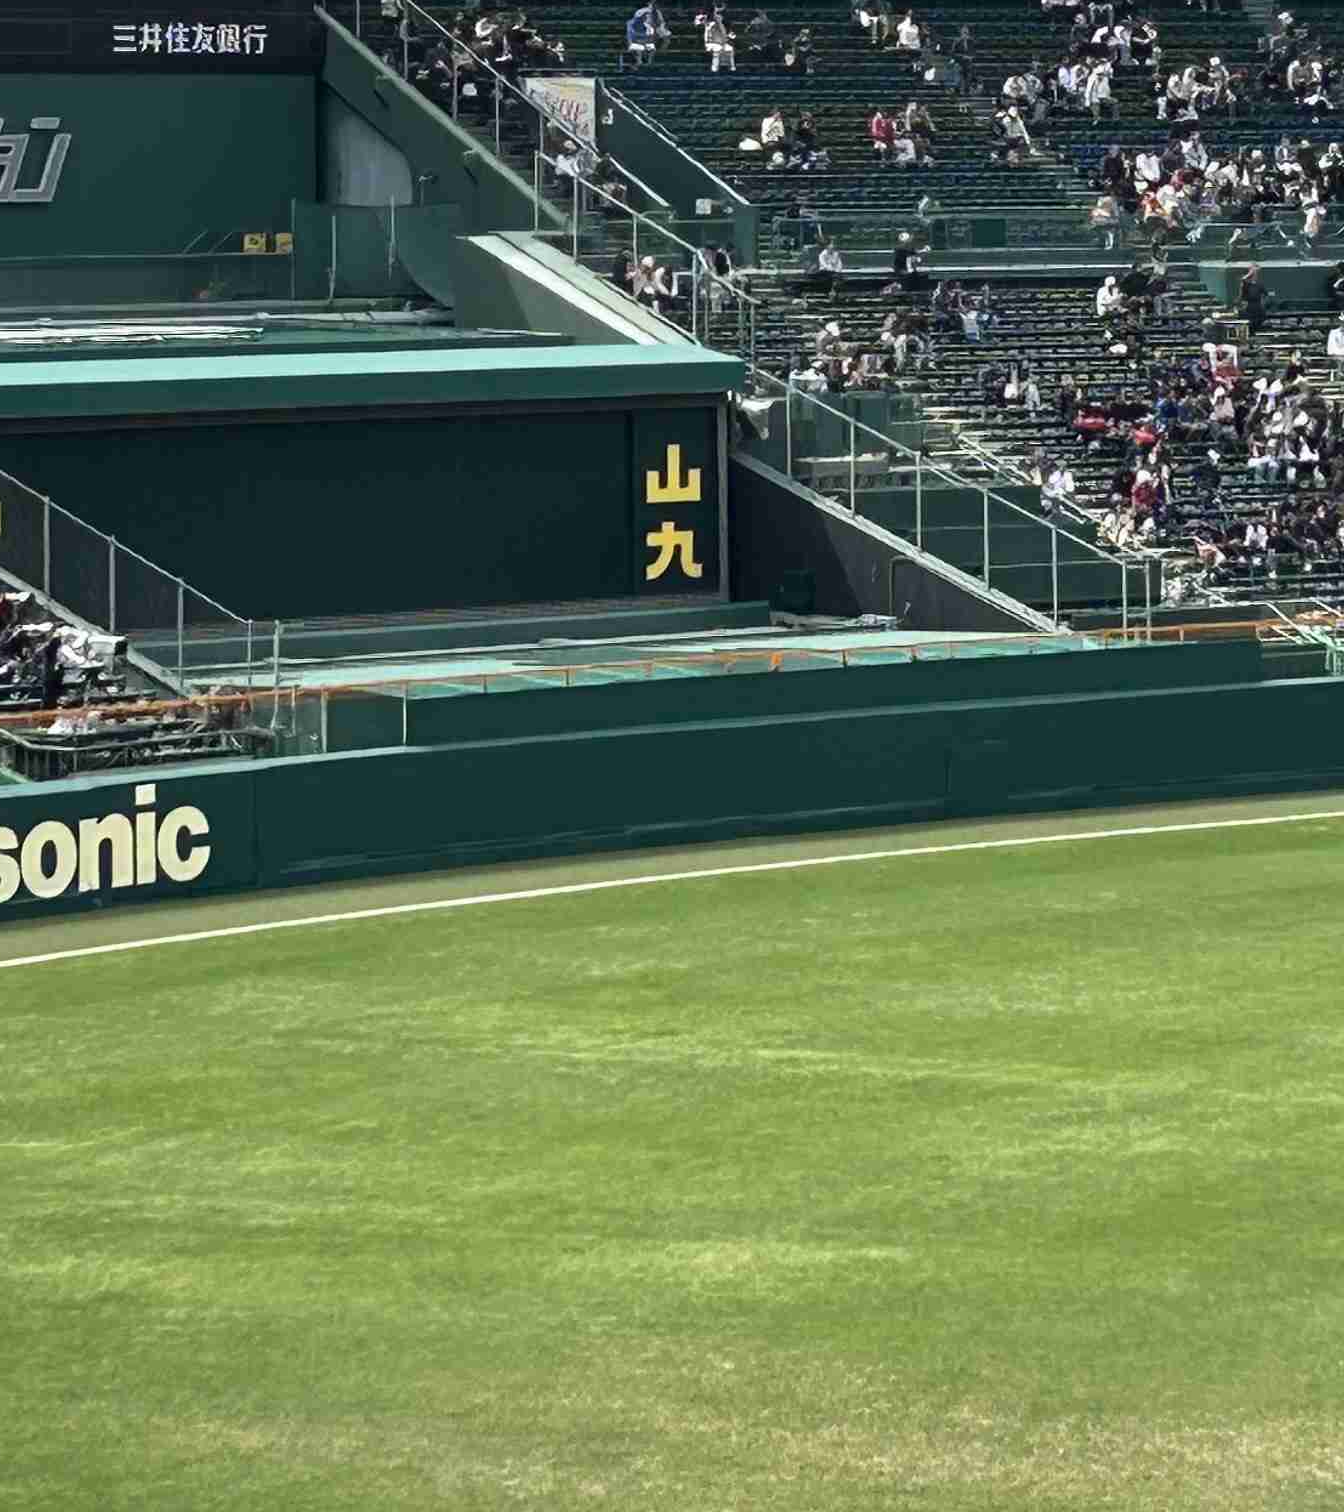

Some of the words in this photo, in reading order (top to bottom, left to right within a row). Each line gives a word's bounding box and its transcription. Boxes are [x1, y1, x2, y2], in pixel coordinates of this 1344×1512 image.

[112, 22, 268, 55] 三井住友銀行
[645, 443, 704, 580] 山九
